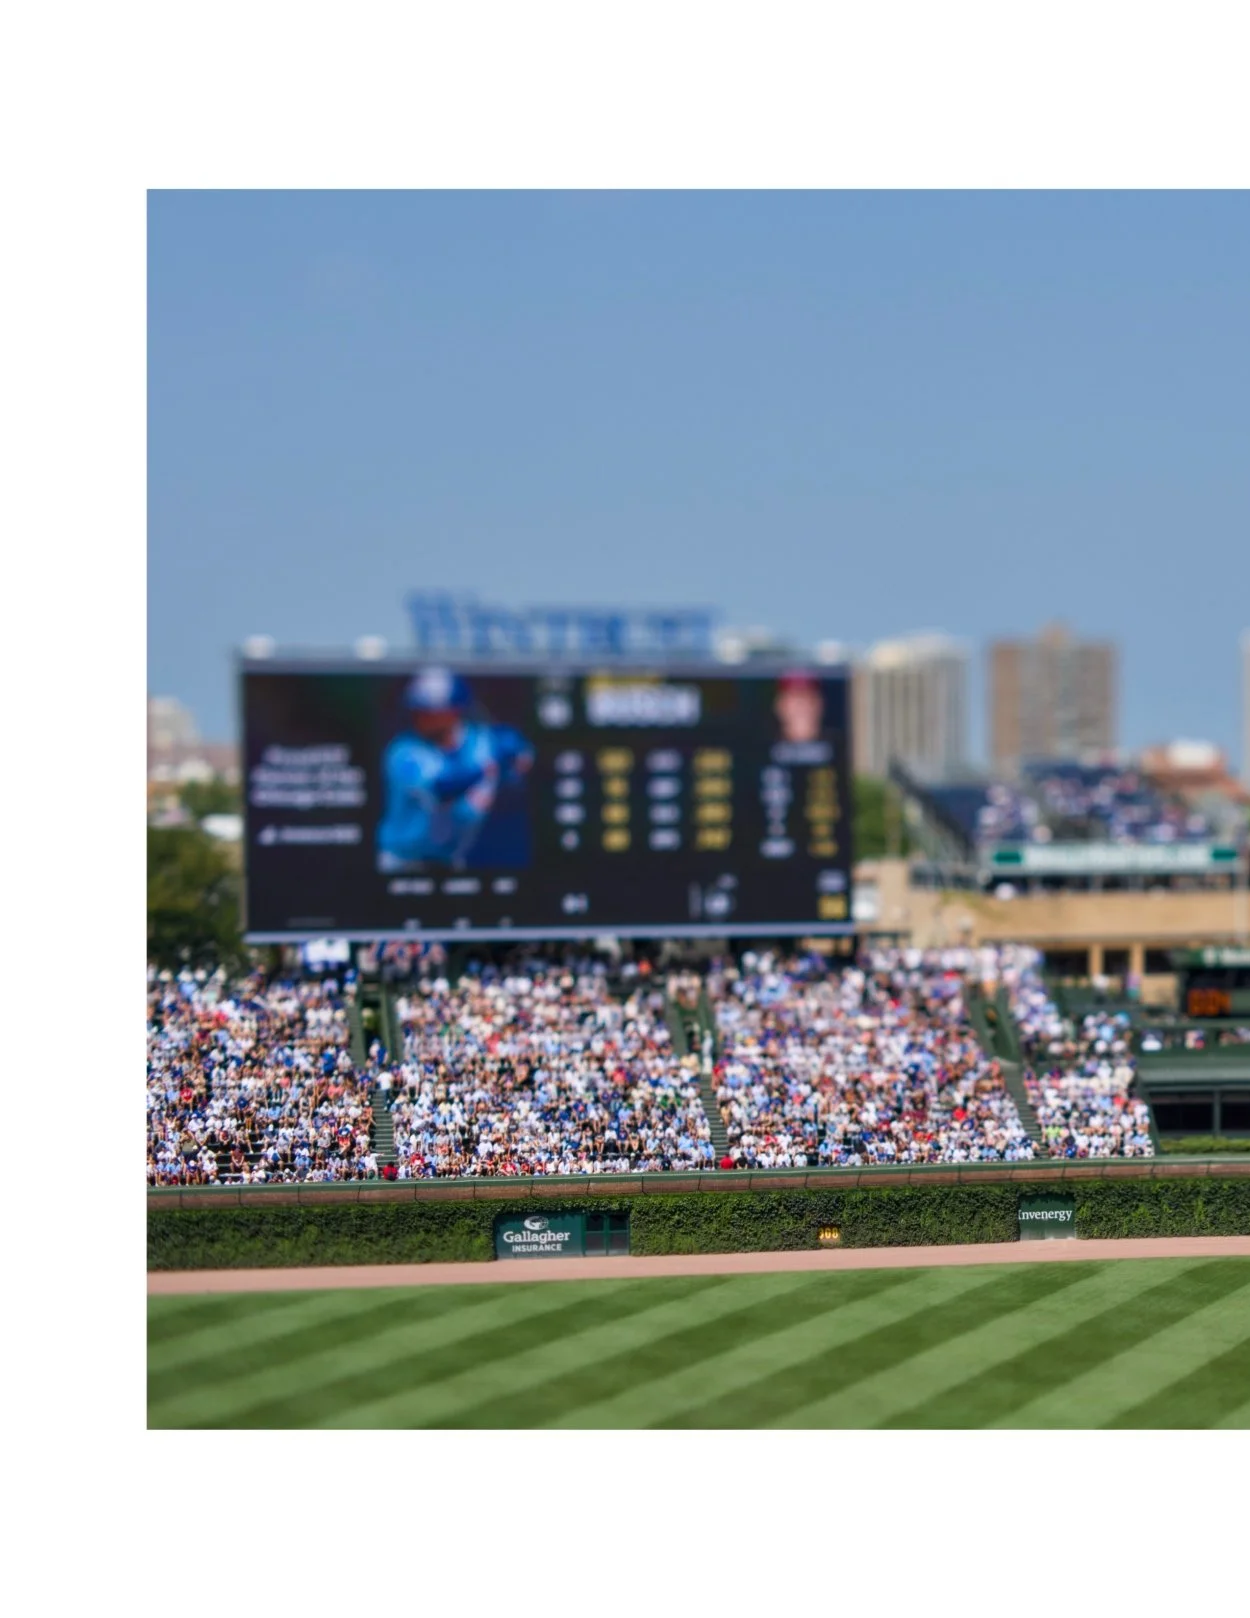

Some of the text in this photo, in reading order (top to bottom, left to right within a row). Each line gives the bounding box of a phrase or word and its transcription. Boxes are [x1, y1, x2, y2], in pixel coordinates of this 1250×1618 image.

[1018, 1209, 1073, 1222] Invenergy
[503, 1230, 571, 1244] Gallagher
[512, 1243, 562, 1253] INSURANCE
